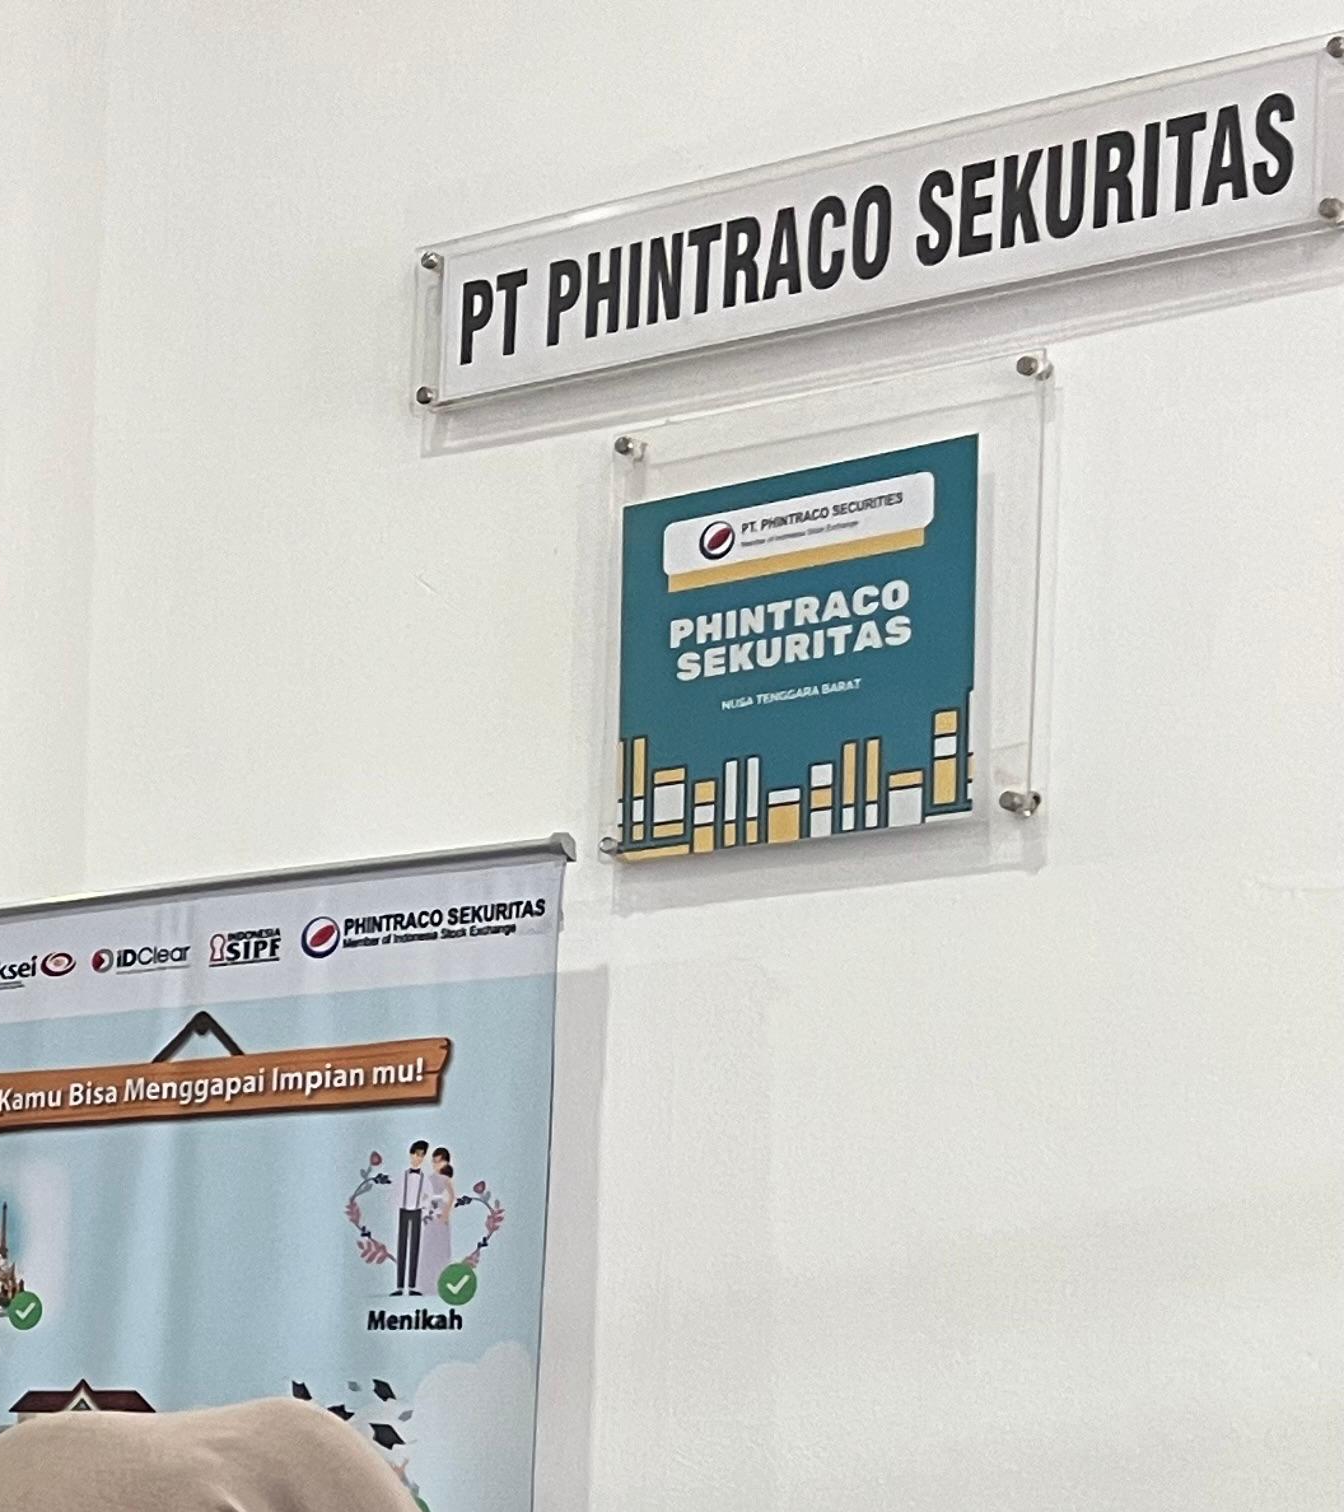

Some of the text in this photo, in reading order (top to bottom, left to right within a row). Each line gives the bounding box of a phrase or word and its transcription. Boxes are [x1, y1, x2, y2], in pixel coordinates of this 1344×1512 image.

[459, 92, 1296, 365] PT PHINTRACO SEKURITAS
[741, 492, 904, 534] PT. PHINTRACO SECURITIES
[669, 578, 911, 649] PHINTRACO
[676, 615, 912, 682] SEKURITAS
[756, 685, 819, 705] TENGGARA
[821, 677, 862, 695] BARAT
[343, 898, 546, 936] PHINTRACO SEKURITAS
[226, 938, 282, 961] SIPF
[68, 1081, 118, 1107] Bisa
[123, 1068, 265, 1104] Menggapai
[271, 1064, 364, 1096] Impian
[372, 1057, 424, 1085] mu!
[366, 1309, 463, 1331] Menikah
